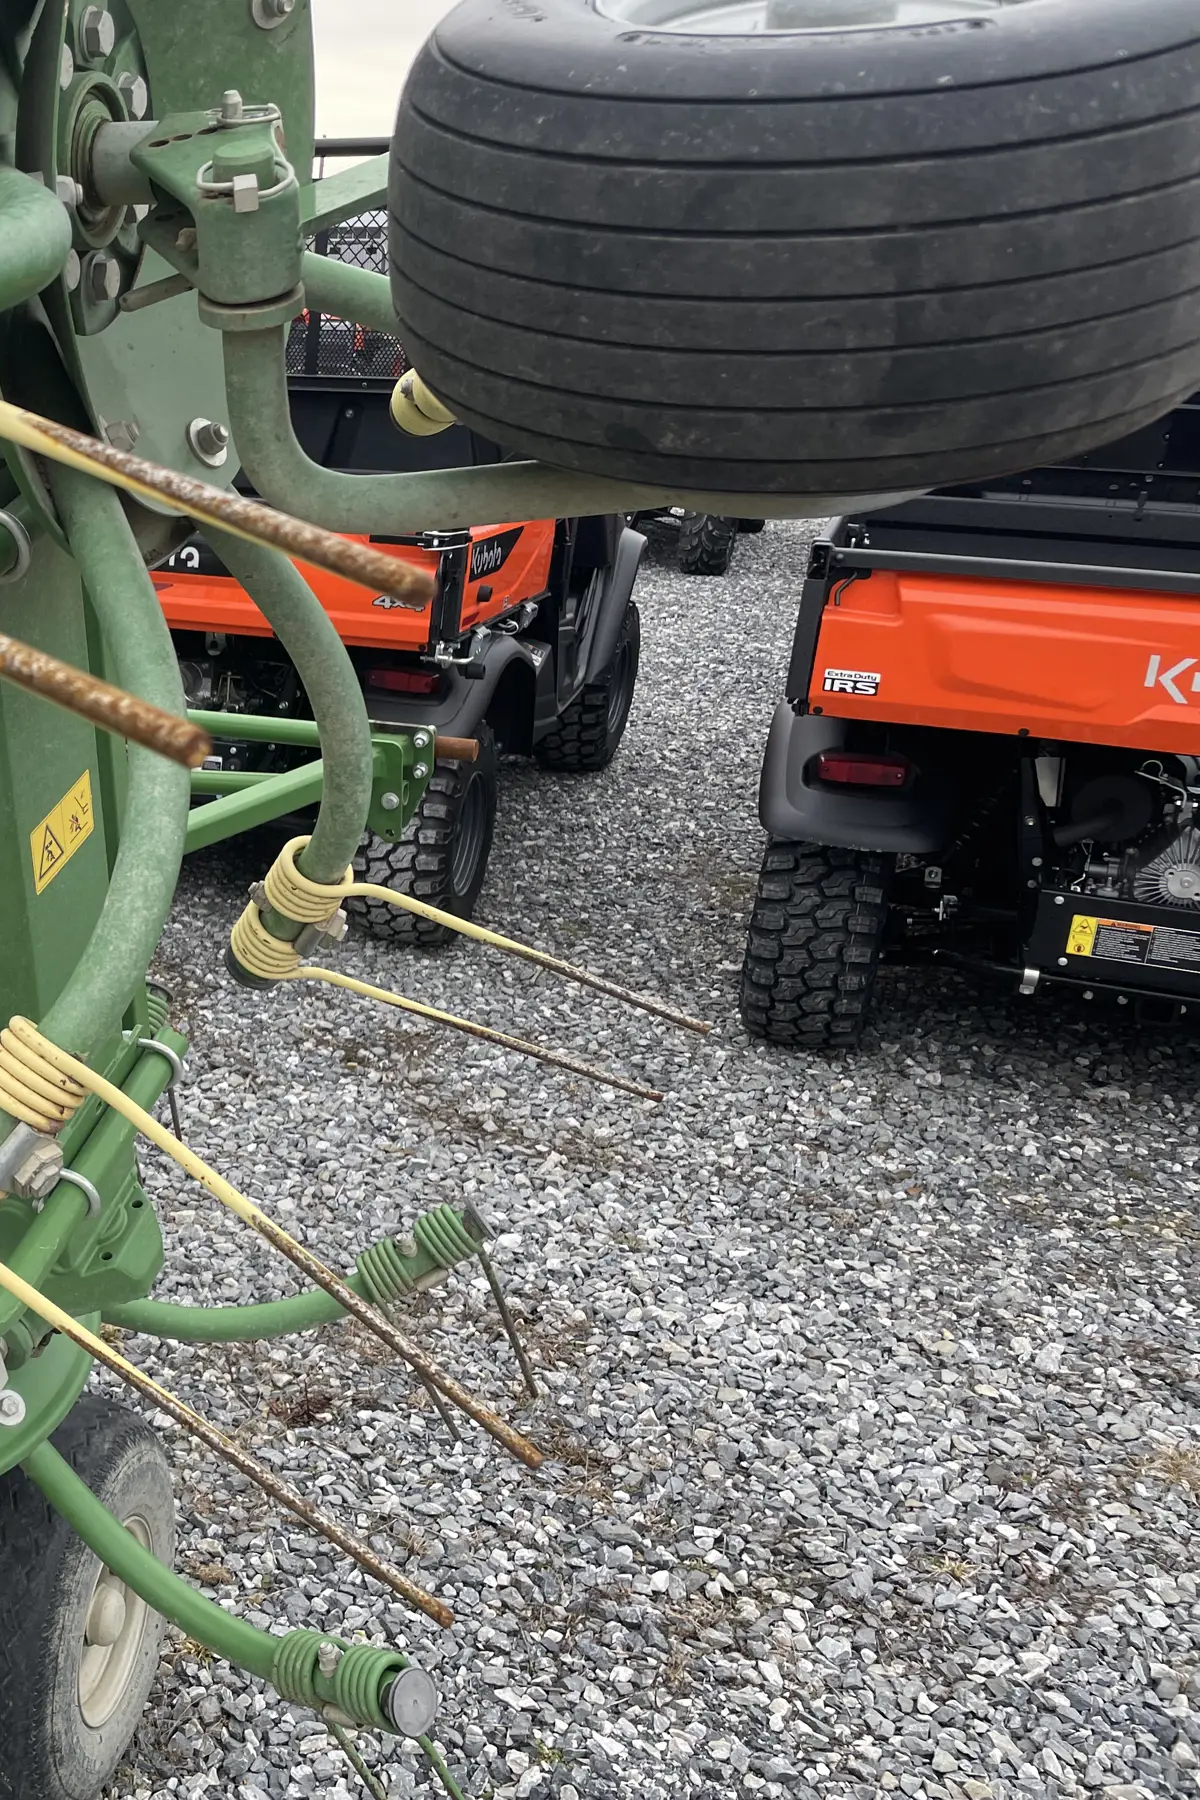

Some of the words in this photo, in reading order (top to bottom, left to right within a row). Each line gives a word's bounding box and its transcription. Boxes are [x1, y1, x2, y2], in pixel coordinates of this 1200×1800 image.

[471, 540, 502, 575] Kubota
[827, 670, 853, 679] Extra
[853, 673, 877, 682] Duty
[824, 678, 876, 695] IRS
